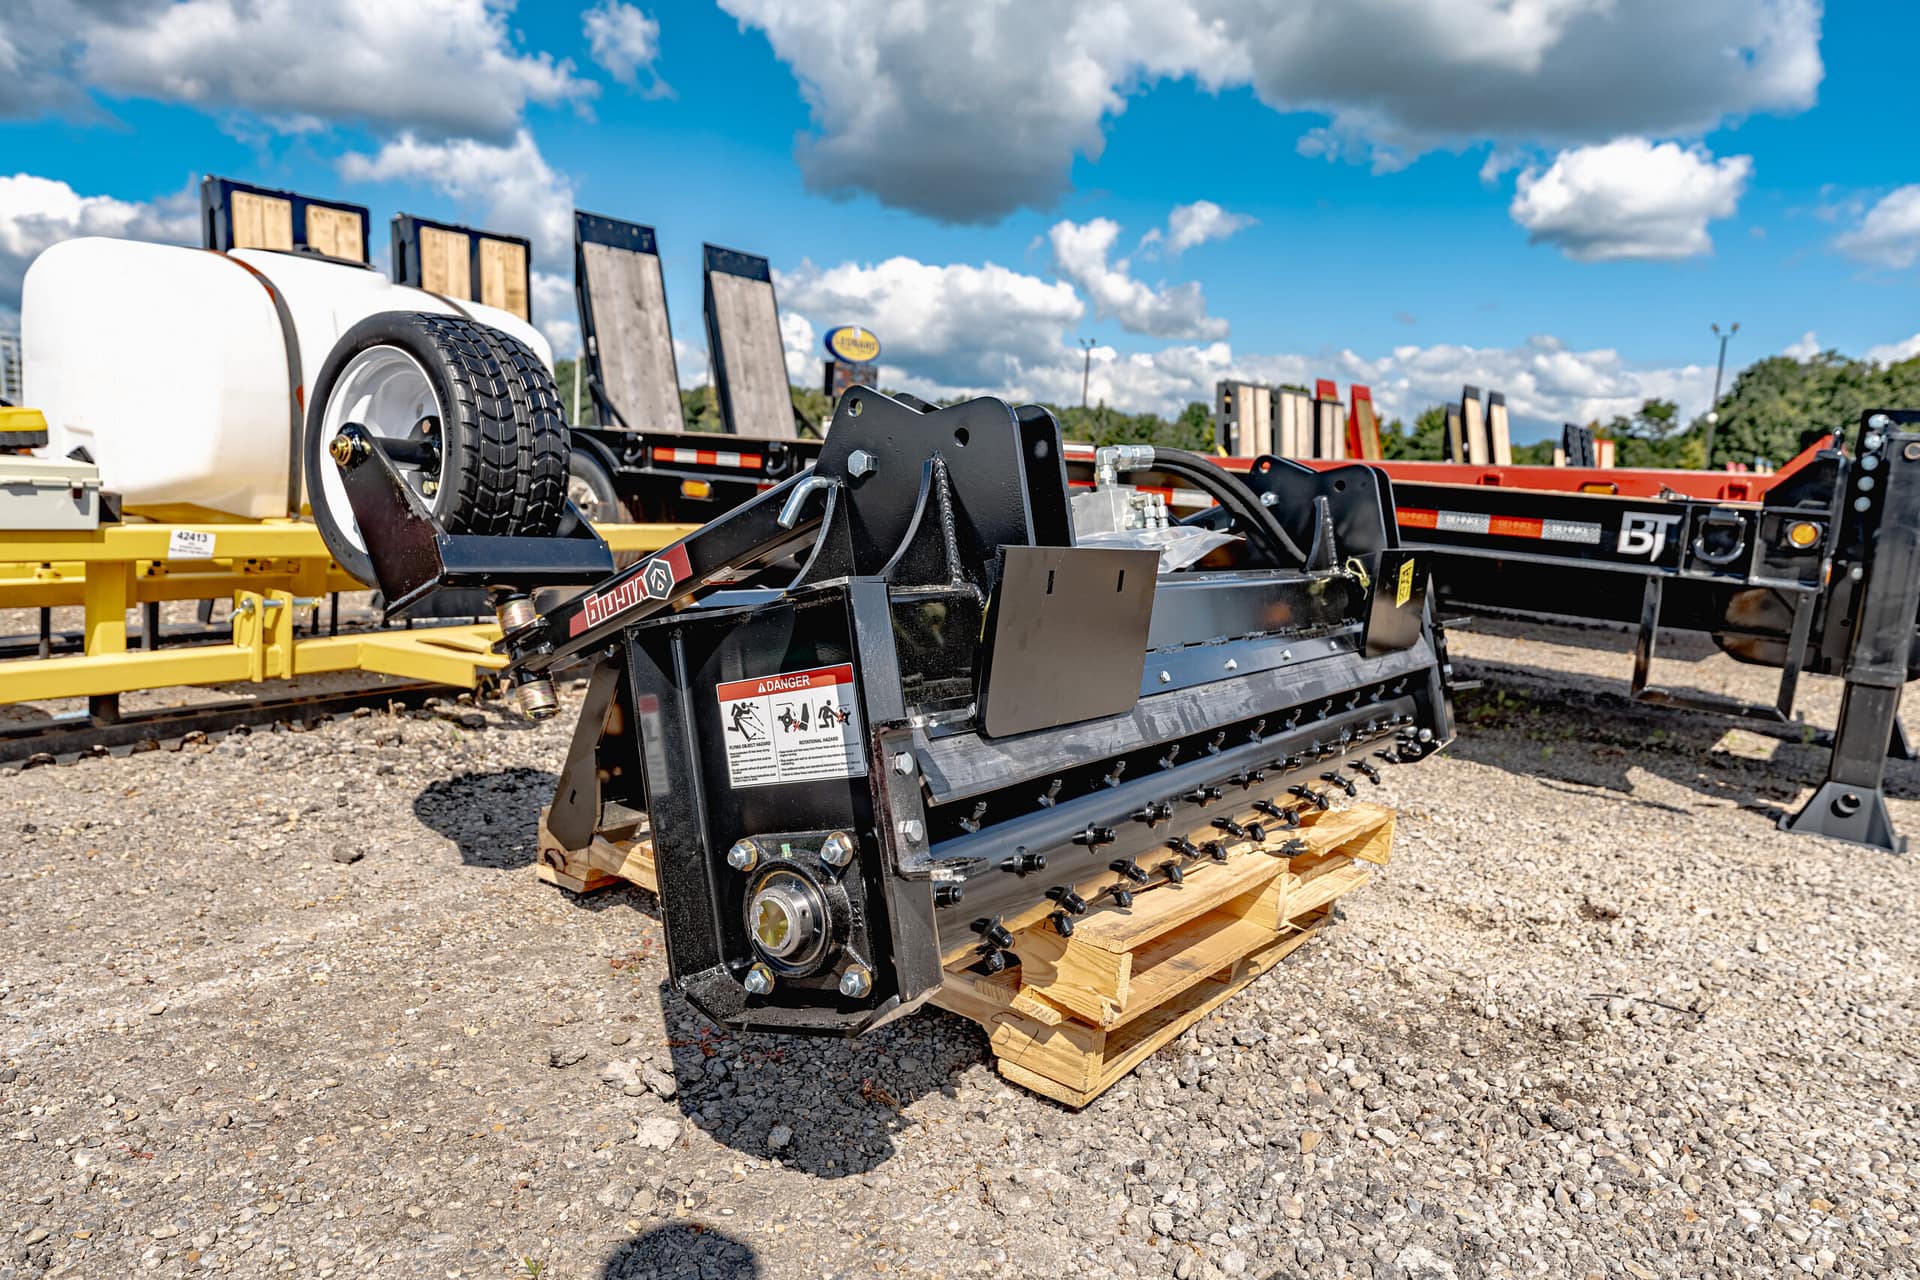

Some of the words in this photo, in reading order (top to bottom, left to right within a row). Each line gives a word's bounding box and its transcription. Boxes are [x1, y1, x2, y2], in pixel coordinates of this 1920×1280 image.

[177, 531, 208, 543] 42413
[1617, 511, 1683, 562] BT
[766, 675, 810, 692] DANGER
